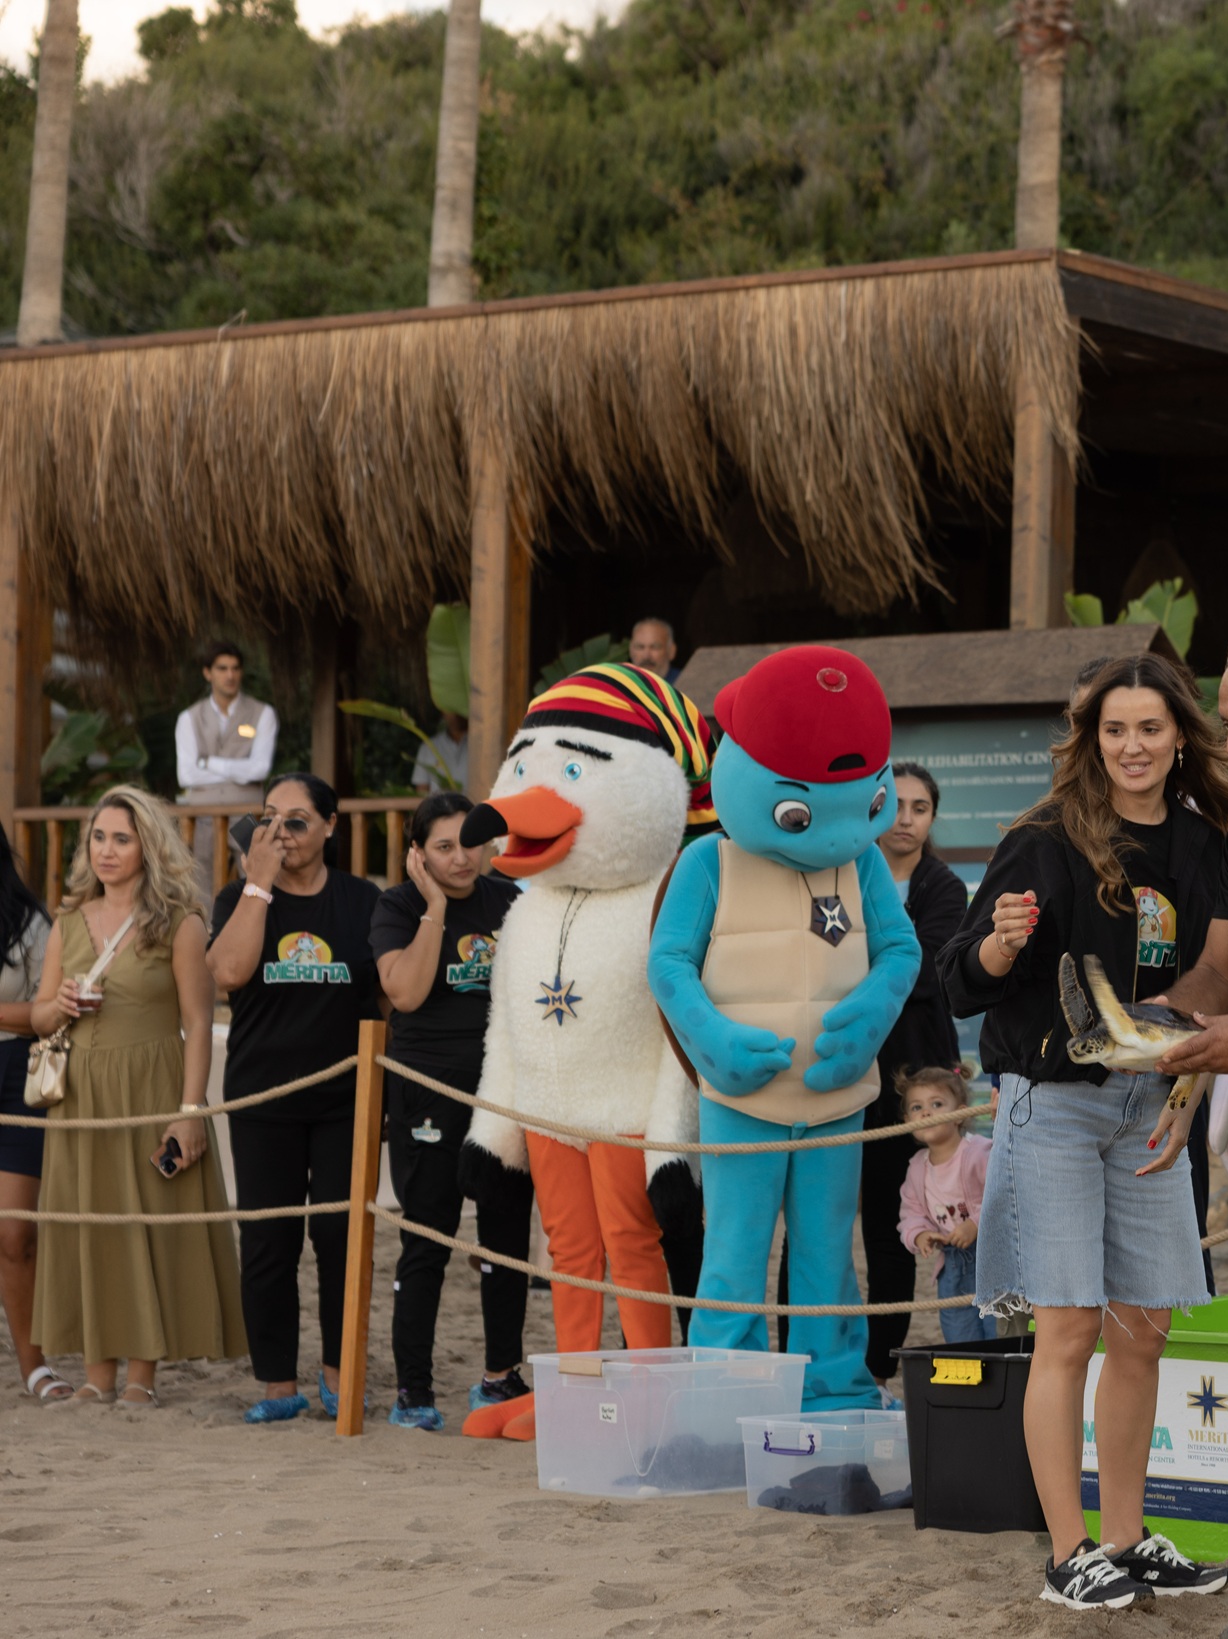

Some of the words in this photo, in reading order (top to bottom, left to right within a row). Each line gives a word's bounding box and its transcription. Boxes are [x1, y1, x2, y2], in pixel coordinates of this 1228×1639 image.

[552, 994, 563, 1006] M
[1188, 1444, 1228, 1453] INTERNATIONAL
[1154, 1456, 1175, 1464] CENTER
[1210, 1455, 1228, 1463] RESORTS
[1142, 1570, 1159, 1580] NB
